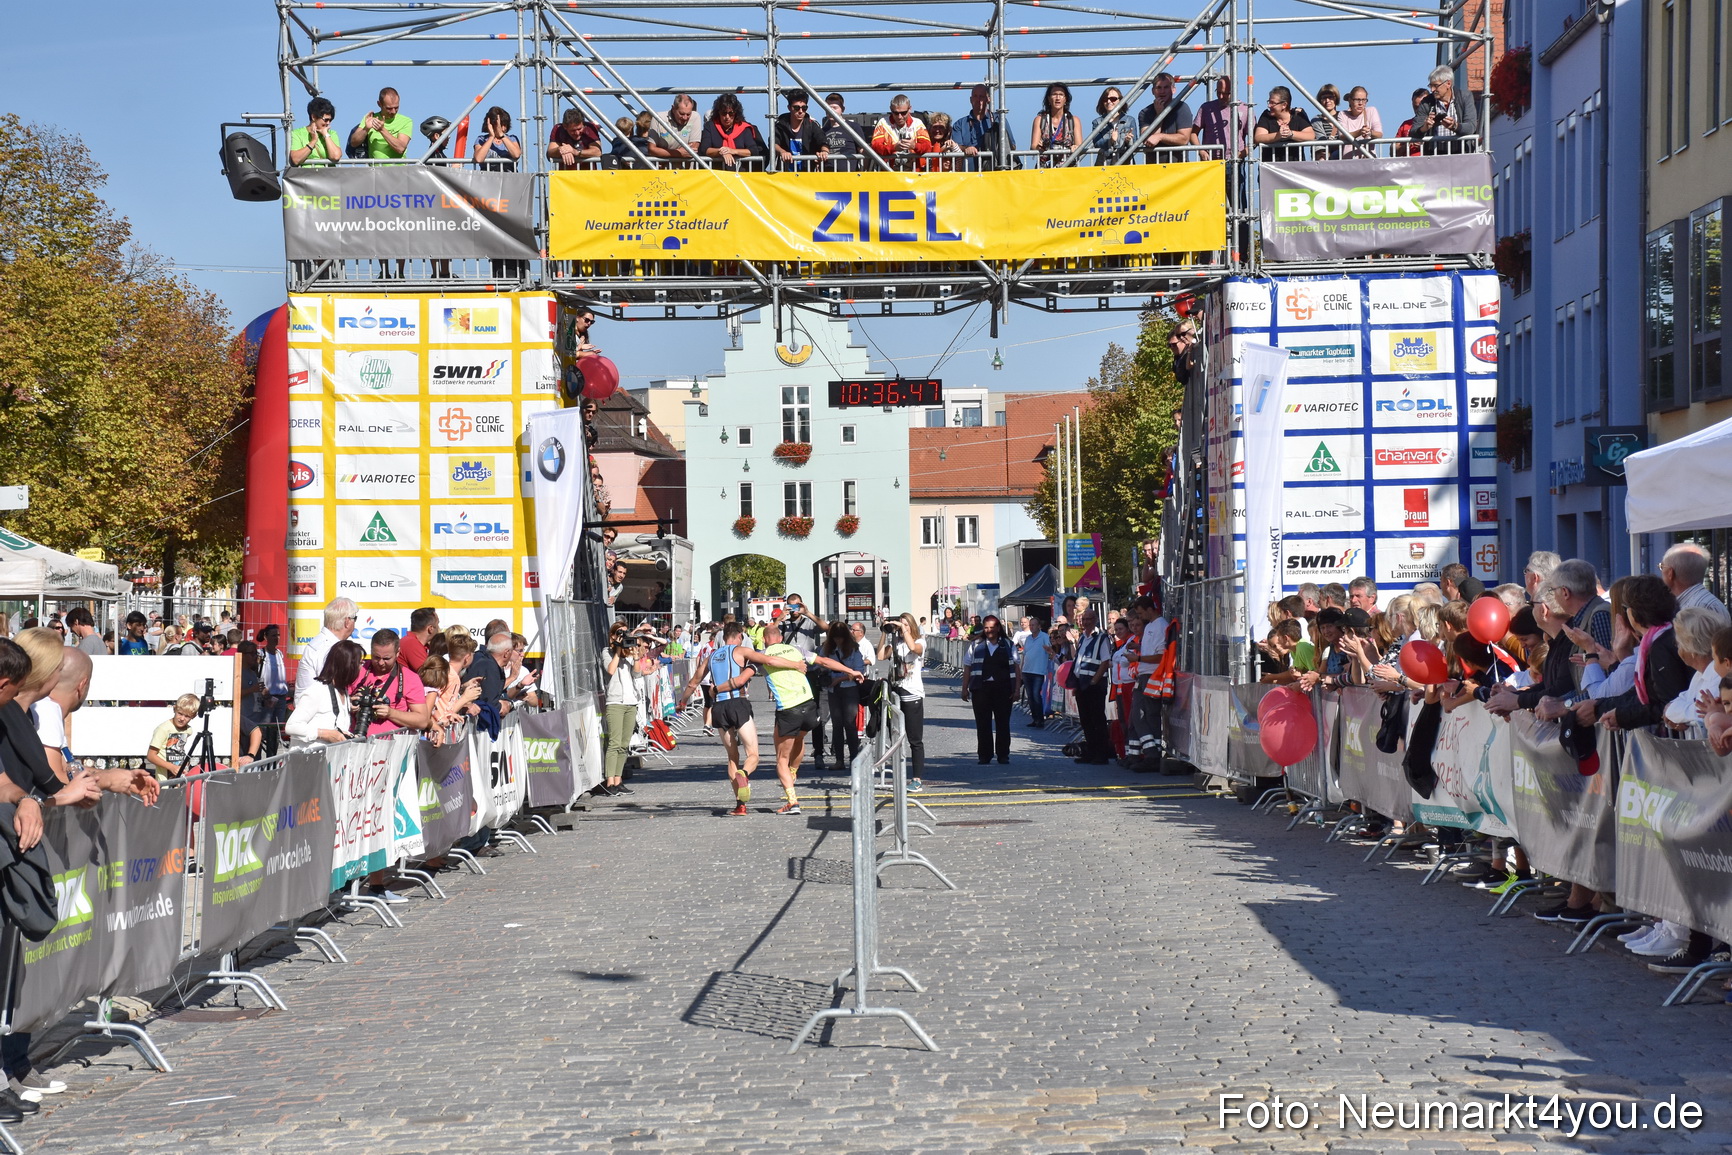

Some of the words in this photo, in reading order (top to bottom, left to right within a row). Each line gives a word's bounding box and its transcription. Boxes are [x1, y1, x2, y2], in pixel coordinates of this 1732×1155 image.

[346, 194, 435, 210] INDUSTRY
[1276, 187, 1428, 220] BOCK
[812, 191, 962, 243] ZIEL
[1046, 215, 1124, 230] Neumarkter
[1128, 209, 1190, 226] Stadtlauf
[314, 217, 481, 232] www.bockonline.de
[585, 219, 663, 232] Neumarkter
[666, 217, 730, 232] Stadtlauf
[1275, 223, 1322, 236] inspired
[1323, 223, 1338, 236] by
[1341, 221, 1374, 232] smart
[1375, 219, 1431, 233] concepts
[1323, 293, 1348, 302] CODE
[1323, 302, 1353, 311] CLINIC
[379, 327, 415, 335] energie
[474, 325, 497, 333] KANN
[1325, 347, 1352, 357] Tagblatt
[1393, 341, 1435, 358] Burgis
[432, 365, 484, 379] swn
[1303, 402, 1359, 413] VARIOTEC
[475, 415, 500, 424] CODE
[1416, 409, 1453, 419] energie
[475, 424, 505, 433] CLINIC
[1378, 449, 1434, 462] charivari
[360, 474, 415, 484] VARIOTEC
[452, 466, 492, 482] Burgis
[1404, 510, 1427, 521] Braun
[473, 533, 510, 542] energie
[1286, 554, 1337, 569] swn
[1398, 562, 1438, 571] Neumarkter
[1286, 568, 1319, 576] stadtwerke
[1320, 567, 1350, 575] neumarkt
[440, 573, 475, 582] Neumarkter
[477, 572, 504, 583] Tagblatt
